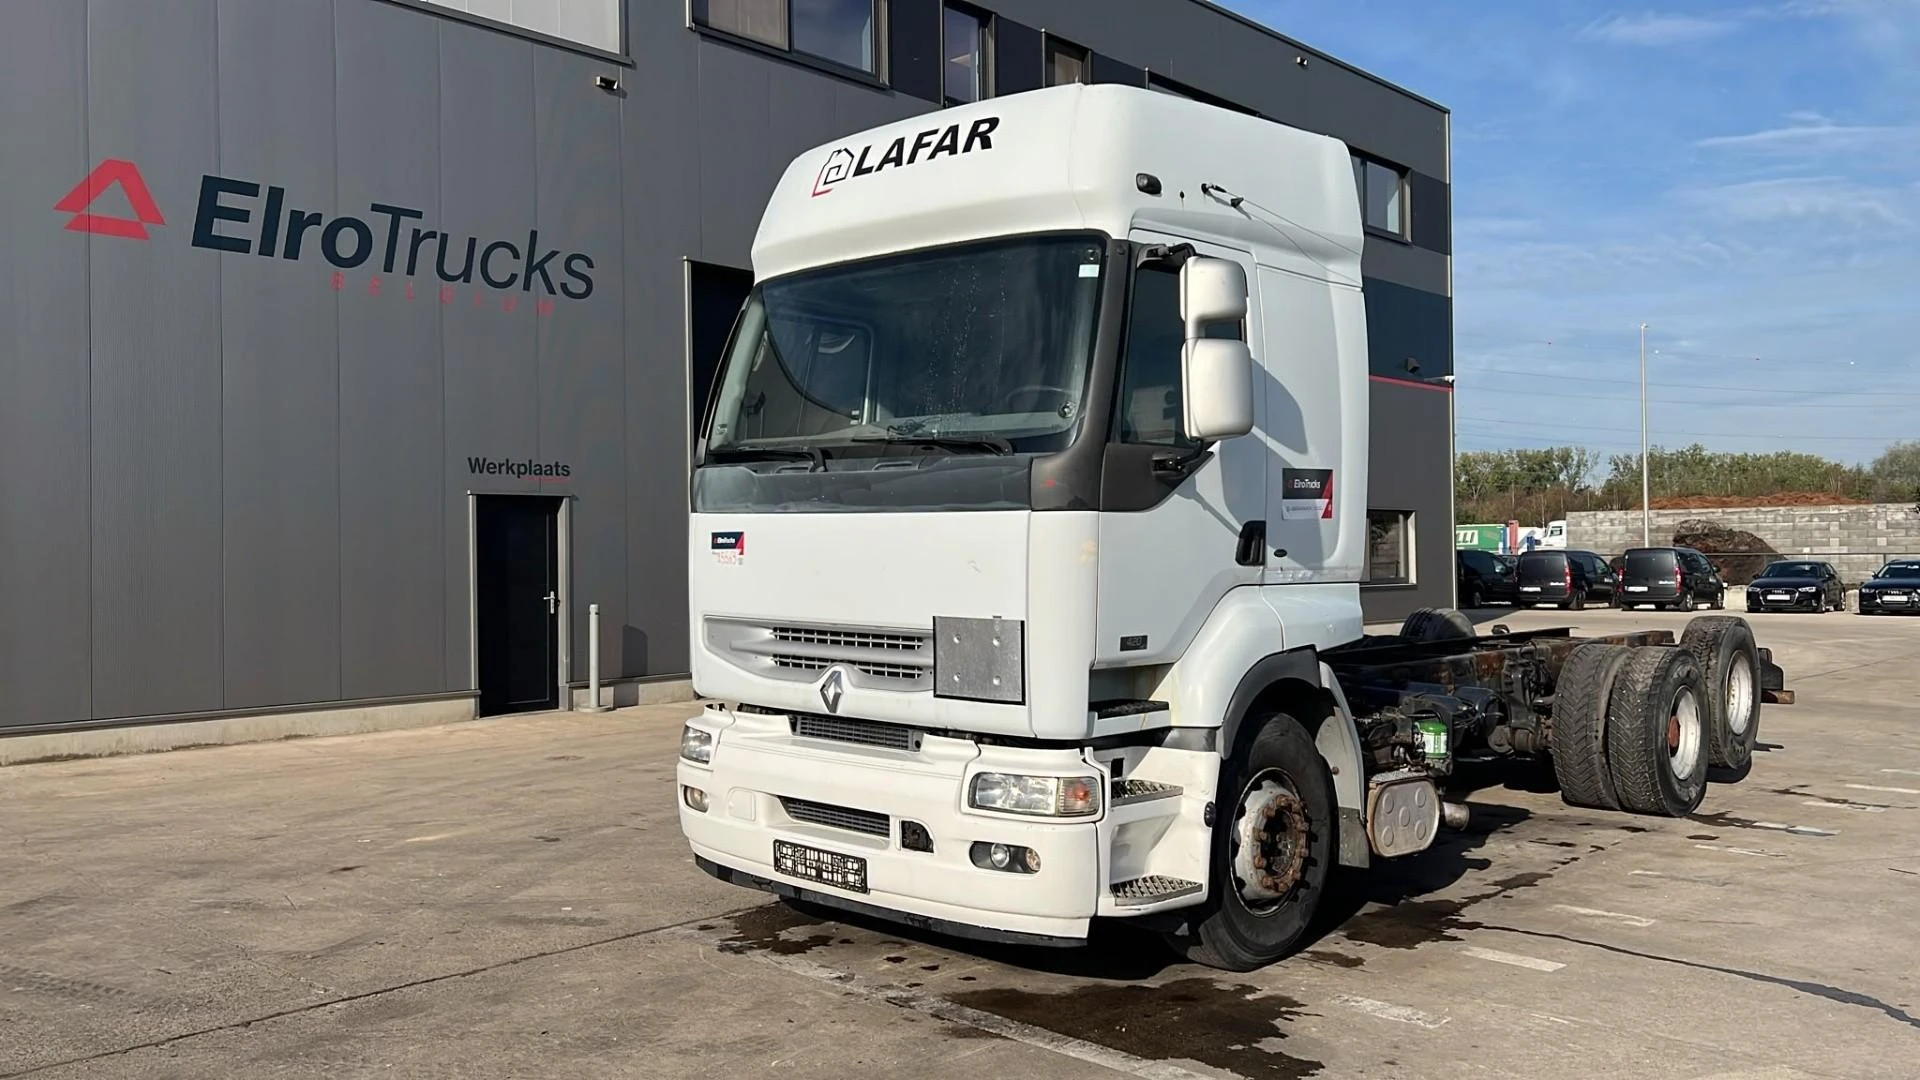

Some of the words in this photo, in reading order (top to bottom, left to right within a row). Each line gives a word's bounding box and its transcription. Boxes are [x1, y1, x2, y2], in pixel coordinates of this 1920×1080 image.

[852, 116, 1000, 177] LAFAR
[191, 174, 595, 301] ElroTrucks
[467, 457, 571, 479] Werkplaats
